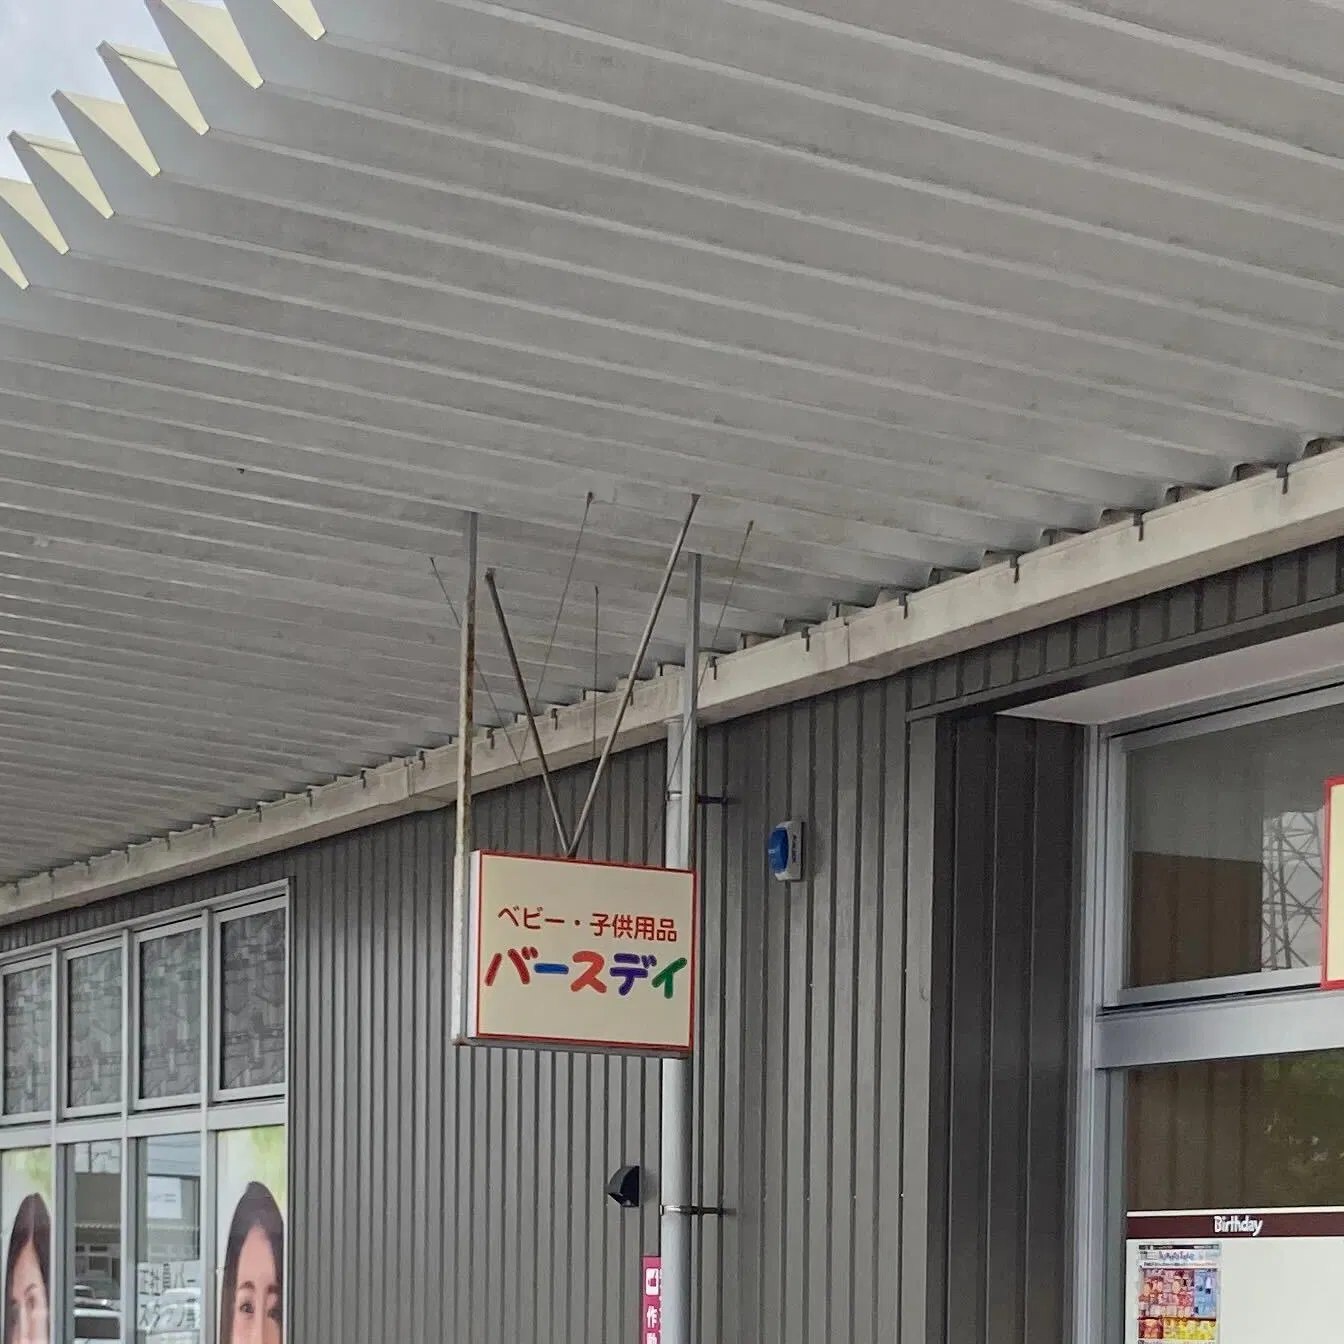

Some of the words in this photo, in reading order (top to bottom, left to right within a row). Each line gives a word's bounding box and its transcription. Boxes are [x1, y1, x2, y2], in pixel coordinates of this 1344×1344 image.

[497, 905, 678, 942] ベビー・子供用品
[485, 946, 688, 999] バースデイ
[1213, 1215, 1264, 1237] Birthday
